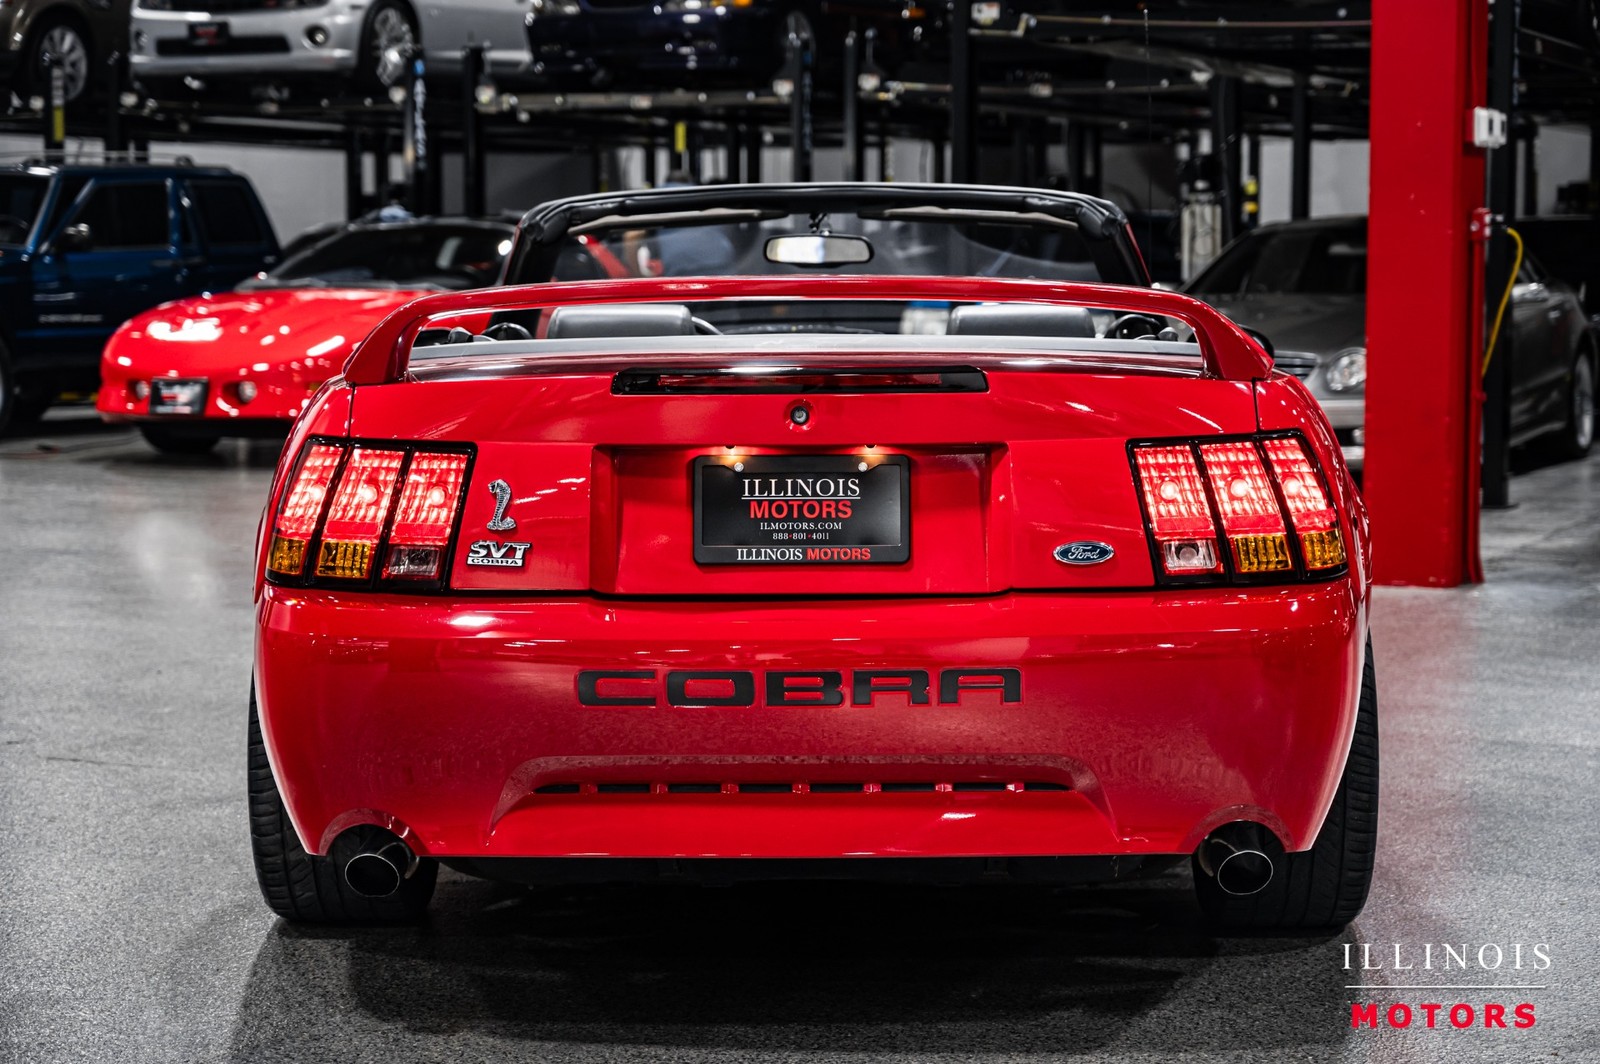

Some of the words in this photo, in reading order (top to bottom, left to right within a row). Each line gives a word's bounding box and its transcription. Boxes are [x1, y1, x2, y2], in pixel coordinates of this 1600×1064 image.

[742, 478, 860, 497] ILLINOIS
[750, 500, 853, 519] MOTORS
[760, 522, 842, 531] ILMOTORS.COM
[468, 540, 531, 559] SVT
[736, 548, 803, 561] ILLINOIS
[806, 548, 871, 561] MOTORS
[1067, 546, 1100, 560] Ford
[577, 668, 1023, 708] COBRA
